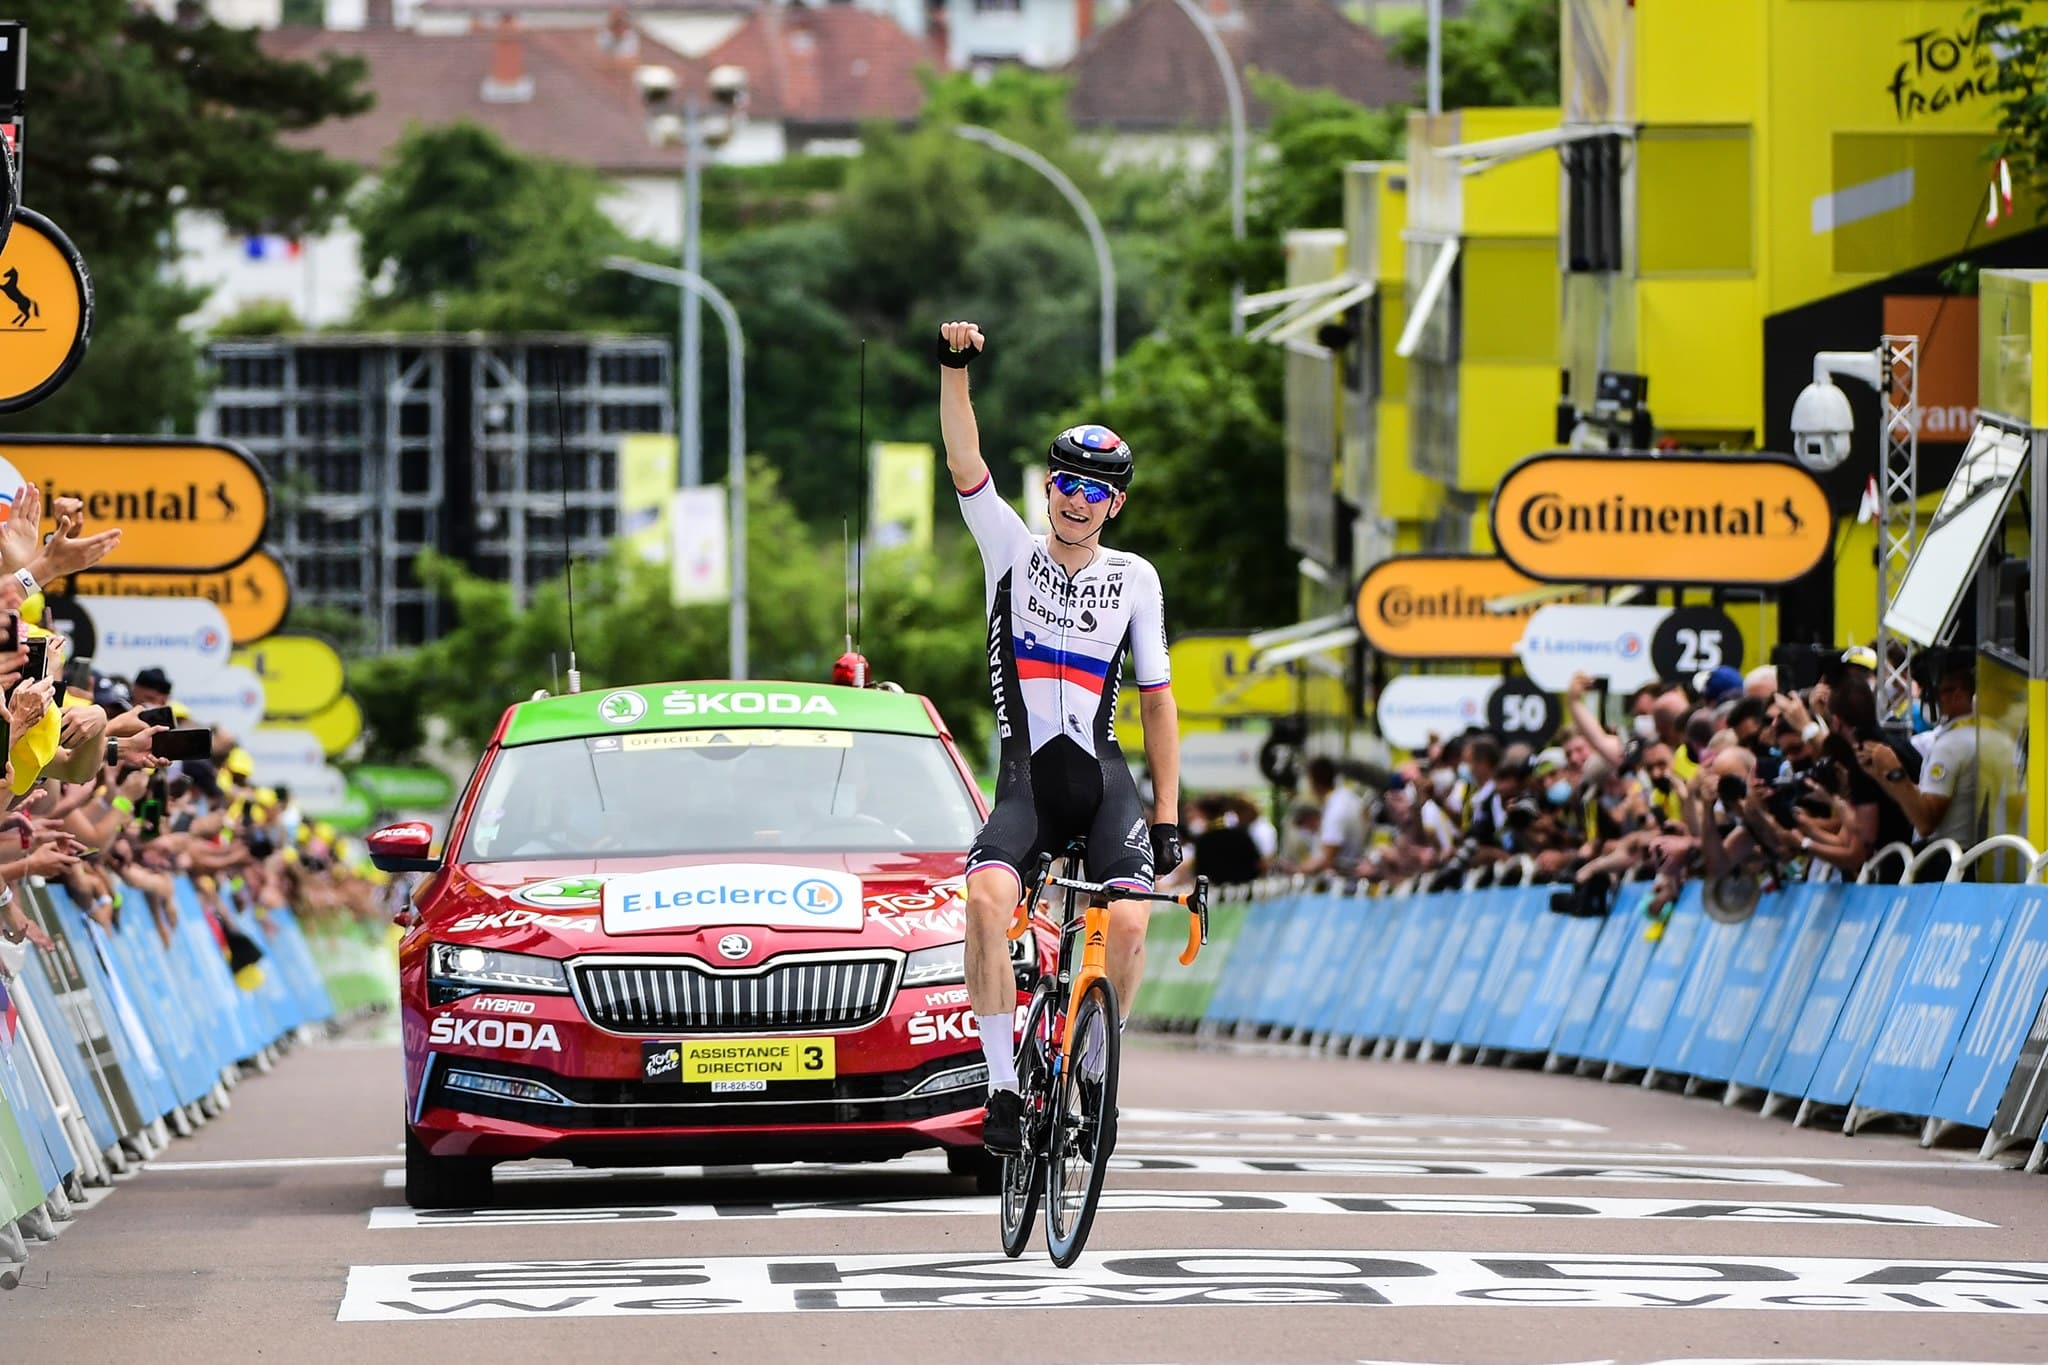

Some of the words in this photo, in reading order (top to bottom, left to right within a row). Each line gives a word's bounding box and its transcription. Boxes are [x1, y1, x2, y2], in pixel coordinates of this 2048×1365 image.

[1519, 493, 1764, 544] Continental
[1027, 566, 1120, 609] VICTORIOUS
[1030, 552, 1123, 598] BAHRAIN
[1028, 595, 1074, 629] Bapco
[1676, 629, 1722, 672] 25
[990, 615, 1012, 738] BAHRAIN
[662, 689, 838, 716] ŠKODA
[1502, 694, 1547, 732] 50
[631, 735, 701, 746] OFFICIEL
[623, 886, 787, 913] E.Leclerc
[447, 909, 597, 933] ŠKODA
[472, 998, 535, 1014] HYBRID
[429, 1012, 562, 1051] ŠKODA
[690, 1046, 790, 1059] ASSISTANCE
[803, 1046, 823, 1070] 3
[697, 1062, 782, 1074] DIRECTION
[714, 1082, 764, 1091] FR-826-SQ
[377, 1296, 742, 1314] We
[1457, 1287, 2048, 1309] Cycli
